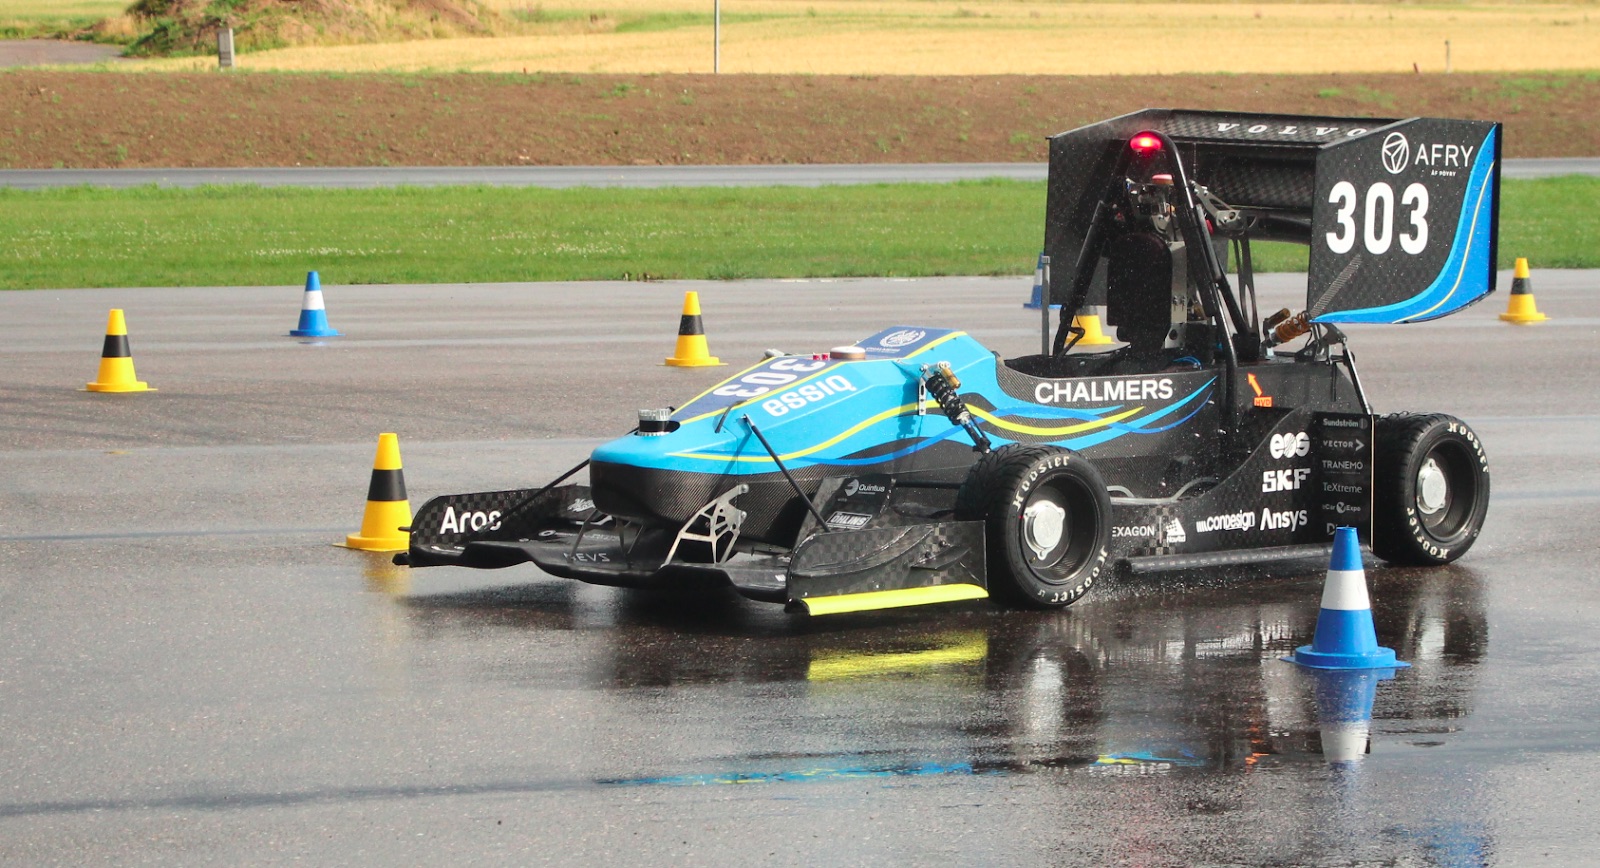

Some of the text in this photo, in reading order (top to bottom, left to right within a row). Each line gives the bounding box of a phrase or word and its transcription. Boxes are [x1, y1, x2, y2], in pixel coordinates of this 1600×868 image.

[1217, 122, 1368, 137] VOLVO
[1415, 143, 1474, 167] AFRY
[1325, 181, 1430, 255] 303
[712, 358, 827, 398] 303
[1034, 378, 1174, 404] CHALMERS
[1322, 418, 1359, 427] Sundström
[1322, 440, 1354, 448] VECTOR
[1321, 460, 1364, 470] TRANEMO
[1262, 468, 1311, 492] SKF
[1322, 481, 1363, 493] TeXtreme
[440, 506, 502, 535] Aros
[1111, 526, 1156, 537] EXAGON
[1259, 508, 1308, 532] Ansys
